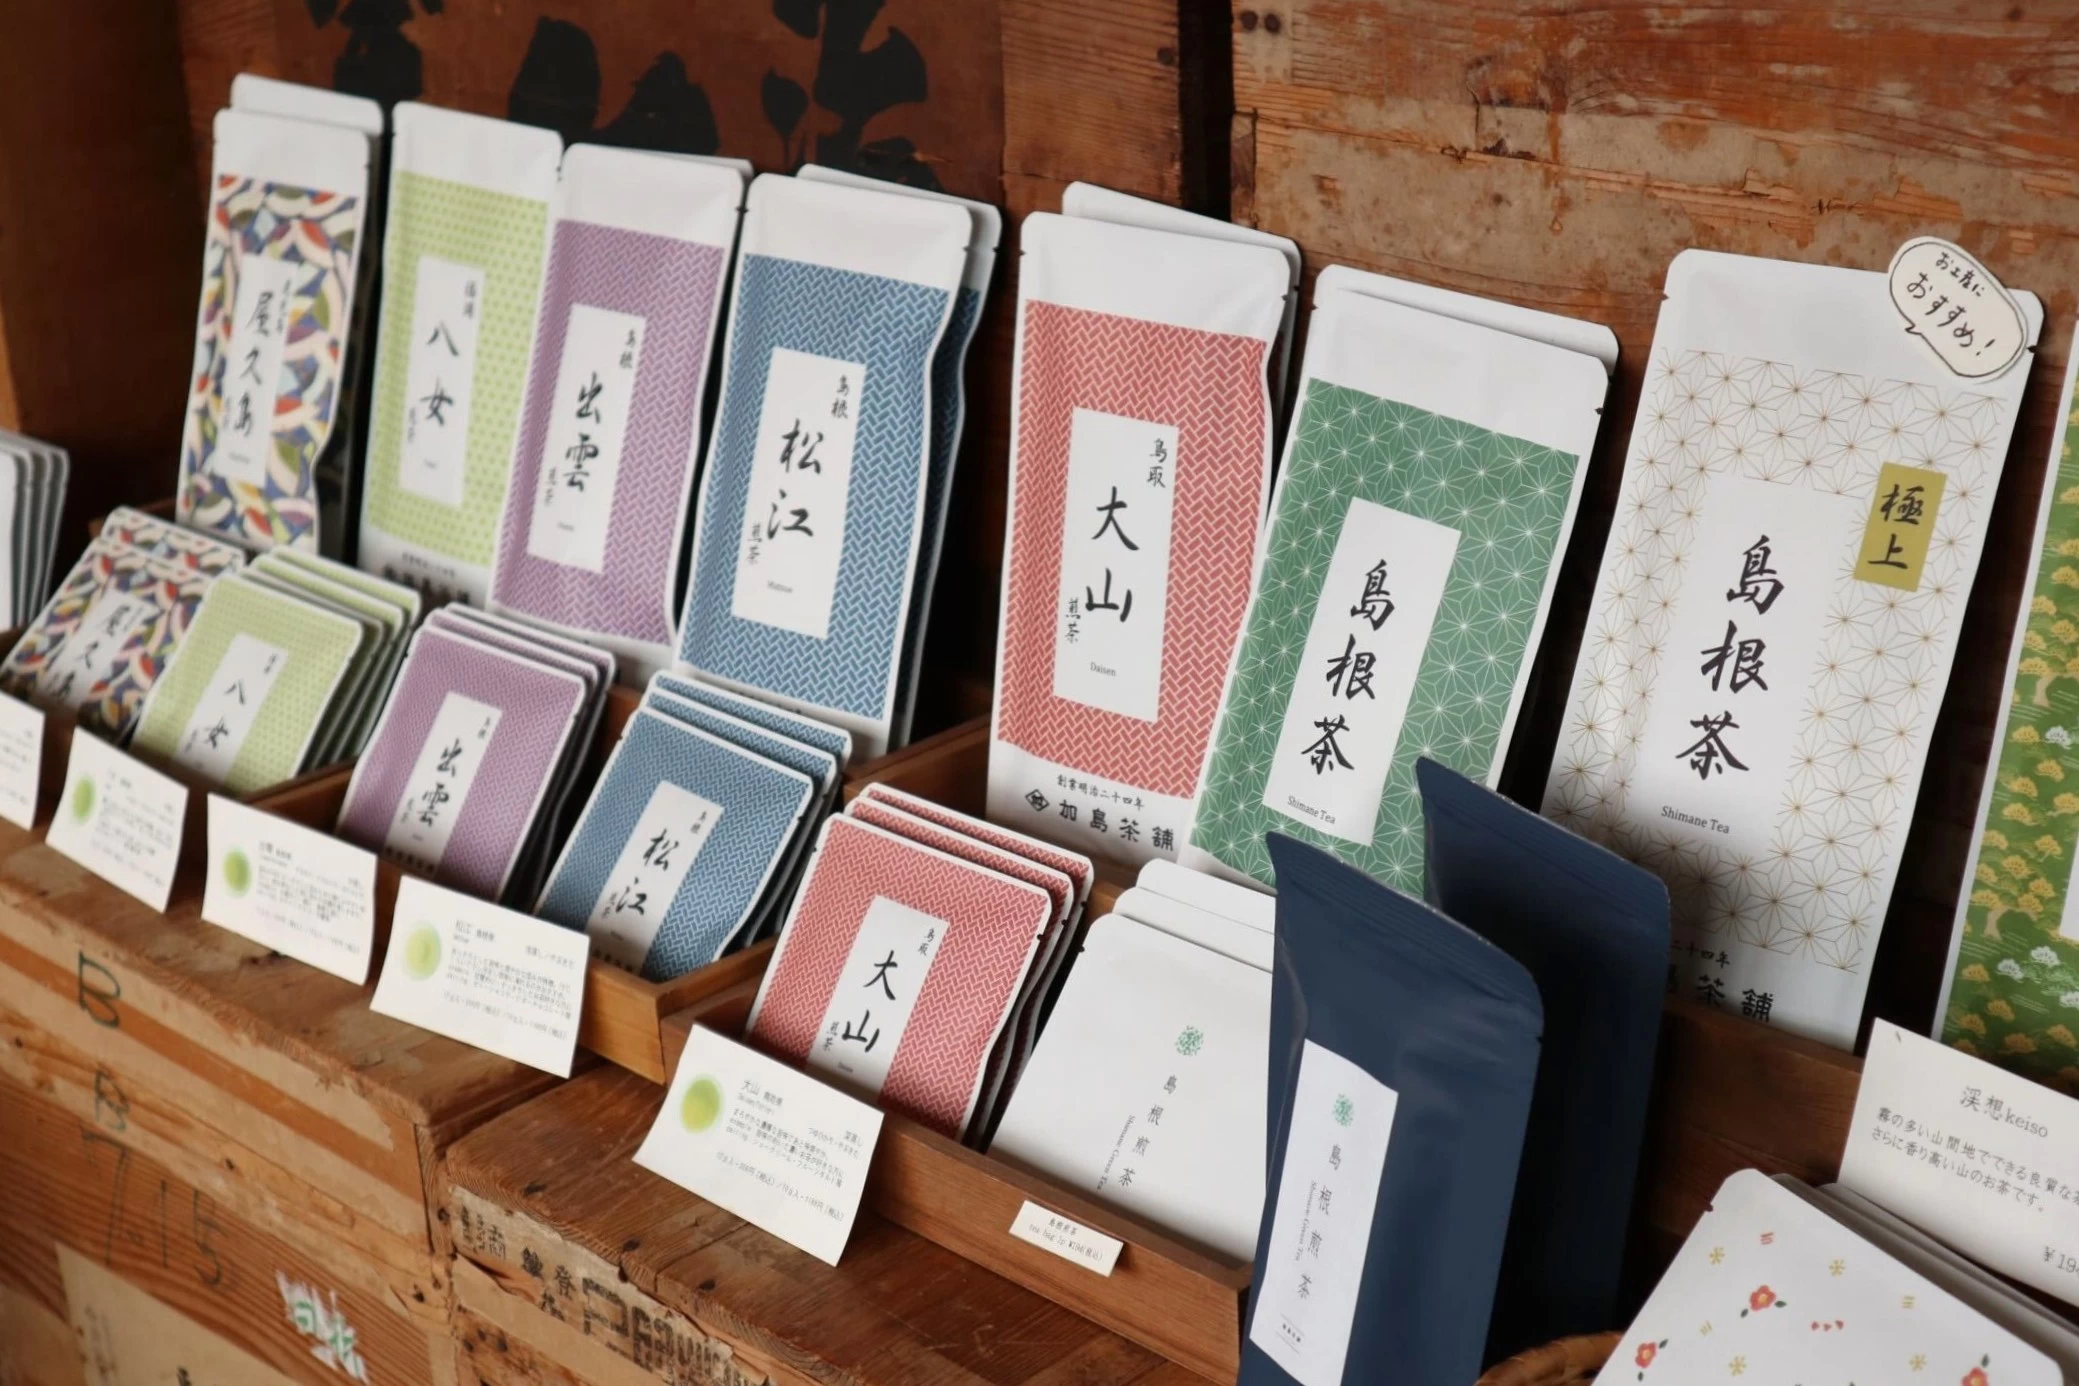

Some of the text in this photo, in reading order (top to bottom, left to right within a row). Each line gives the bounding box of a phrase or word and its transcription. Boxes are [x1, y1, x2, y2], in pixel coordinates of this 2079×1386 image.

[420, 320, 459, 427] 八女
[831, 374, 850, 419] 島根
[562, 371, 603, 492] 出雲
[1146, 438, 1168, 489] 鳥取
[767, 418, 824, 540] 松江
[1085, 485, 1140, 622] 大山
[1867, 483, 1925, 570] 極上
[1090, 662, 1117, 677] Daisen
[1301, 559, 1395, 776] 島根茶
[1675, 534, 1785, 780] 島根茶
[205, 679, 246, 749] 八女
[417, 737, 462, 827] 出雲
[1056, 774, 1145, 811] 創業明治二十四年
[1059, 799, 1174, 851] 加島茶舗
[1287, 795, 1336, 825] Shimane Tea
[1661, 805, 1730, 835] Shimane Tea
[616, 827, 679, 916] 松江
[842, 950, 898, 1053] 大山
[1118, 1075, 1177, 1187] 島根煎茶
[2043, 1246, 2079, 1276] ¥19
